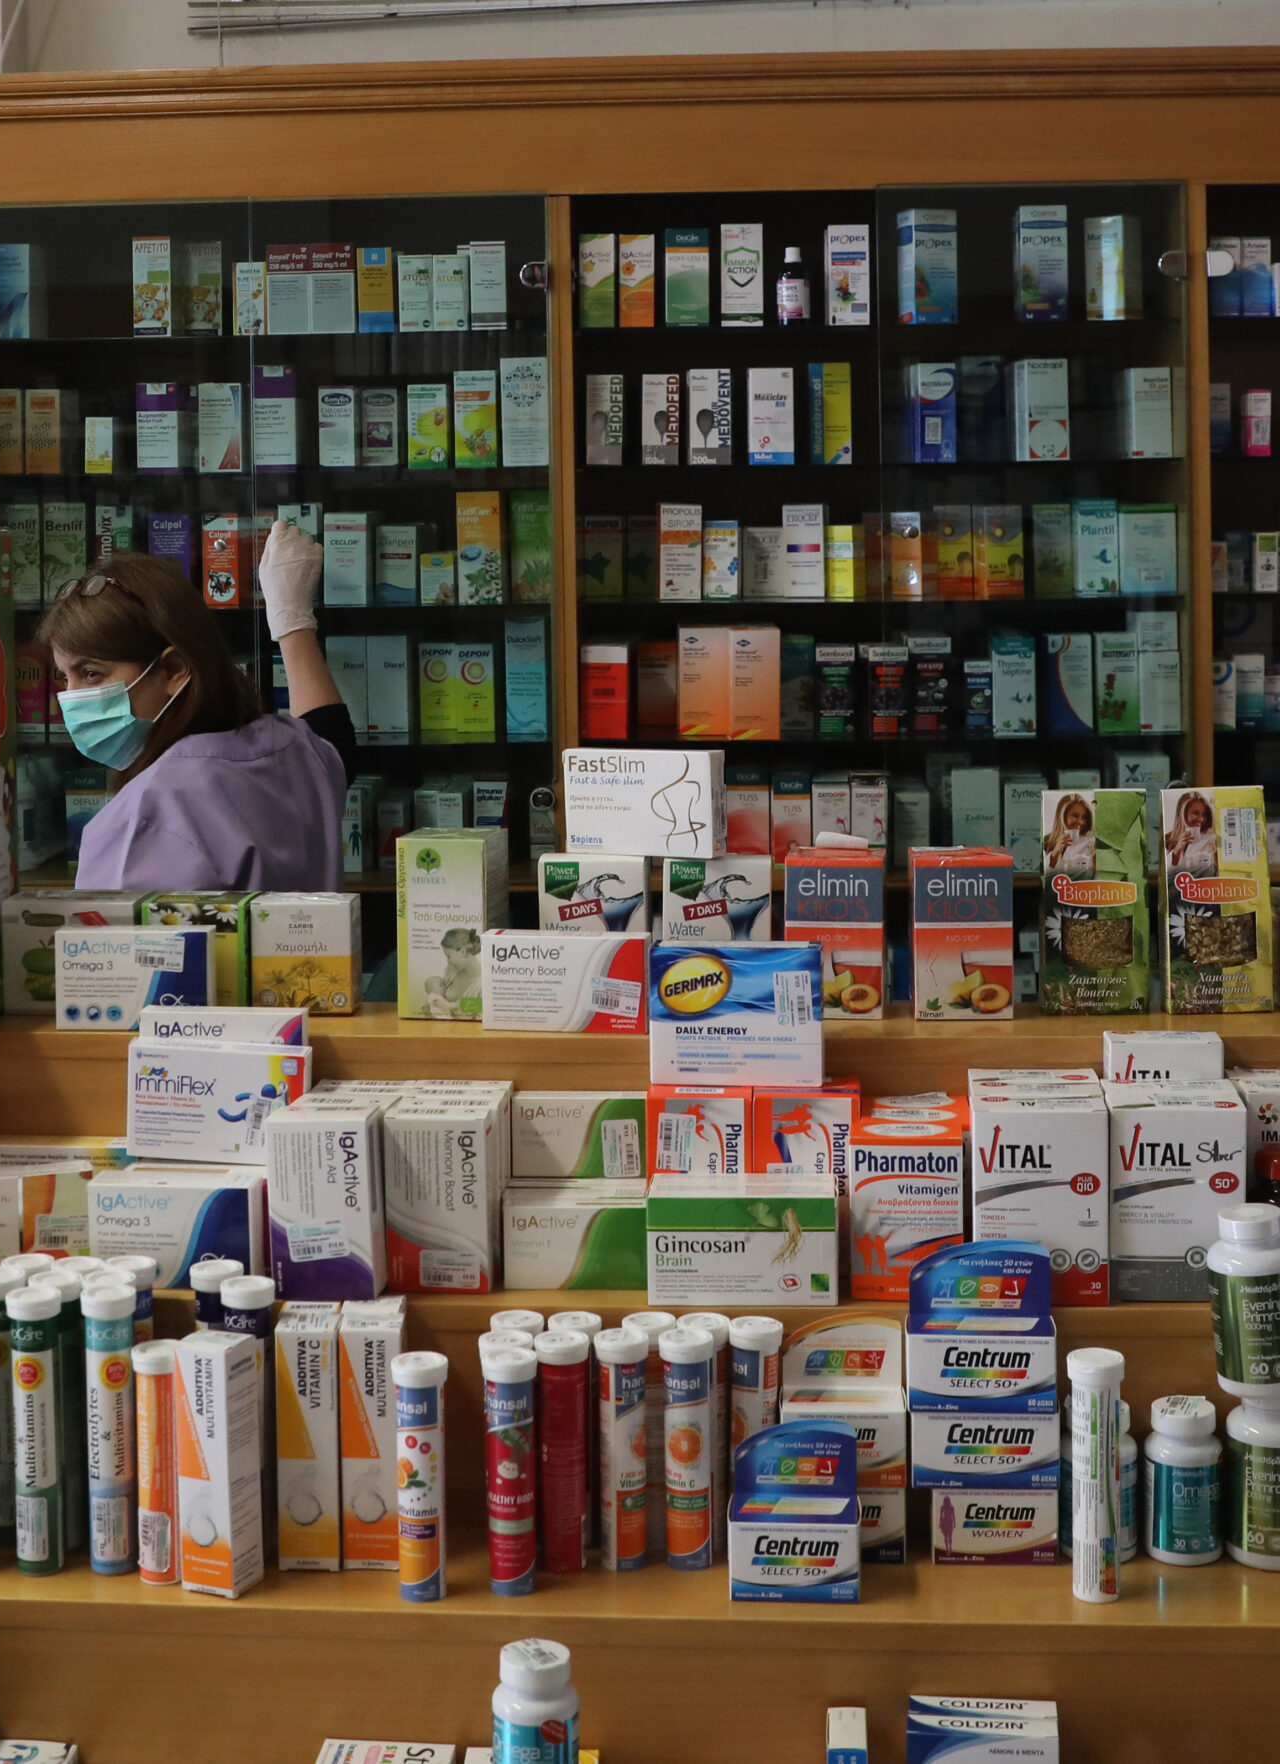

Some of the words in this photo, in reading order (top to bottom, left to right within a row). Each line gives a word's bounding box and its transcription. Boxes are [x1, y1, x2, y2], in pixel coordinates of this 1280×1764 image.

[830, 233, 866, 245] propex
[915, 237, 953, 249] propex
[621, 250, 652, 261] IgActive
[727, 258, 757, 267] IMMUN
[727, 266, 758, 275] ACTION
[754, 392, 788, 402] Moxiclav
[608, 375, 623, 447] MEDOFED
[718, 370, 731, 449] MEDOVENT
[662, 507, 701, 516] PROPOLIS
[45, 520, 84, 532] Benlif
[153, 519, 182, 532] Calpol
[1081, 524, 1114, 536] Plantil
[913, 640, 948, 649] Sambucol
[421, 648, 452, 657] DEPON
[458, 649, 490, 658] DEPON
[818, 650, 854, 658] Sambucol
[872, 650, 907, 658] Sambucol
[568, 755, 645, 774] FastSlim
[570, 775, 590, 785] Fast
[591, 776, 598, 785] &
[599, 775, 619, 785] Safe
[620, 775, 645, 785] slim
[570, 834, 603, 846] Sapiens
[554, 872, 579, 880] HEALTH
[680, 871, 704, 880] HEALTH
[798, 868, 869, 897] elimin
[927, 869, 999, 897] elimin
[1062, 883, 1132, 903] Bioplants
[1186, 882, 1256, 902] Bioplants
[564, 908, 570, 918] 7
[571, 902, 598, 917] DAYS
[689, 908, 695, 917] 7
[696, 902, 722, 916] DAYS
[668, 923, 706, 937] Water
[63, 939, 131, 956] IgActive
[274, 941, 328, 953] Χαμομήλι
[492, 944, 561, 961] IgActive
[63, 961, 103, 973] Omega
[106, 960, 114, 970] 3
[491, 965, 536, 977] Memory
[538, 965, 567, 976] Boost
[664, 969, 724, 997] GERIMAX
[918, 1010, 944, 1018] Tilman
[675, 1026, 705, 1036] DAILY
[707, 1026, 748, 1036] ENERGY
[134, 1072, 215, 1097] ImmiFlex
[325, 1131, 337, 1164] Brain
[444, 1129, 455, 1178] Memory
[979, 1124, 1052, 1173] VITAL
[854, 1150, 959, 1173] Pharmaton
[325, 1166, 337, 1184] Aid
[898, 1184, 958, 1199] Vitamigen
[1076, 1182, 1094, 1193] Q10
[444, 1179, 456, 1212] Boost
[878, 1197, 931, 1208] Αναβράζοντα
[96, 1214, 140, 1228] Omega
[143, 1214, 151, 1226] 3
[655, 1235, 746, 1254] Gincosan
[655, 1254, 692, 1267] Brain
[309, 1339, 321, 1350] C
[942, 1346, 1031, 1368] Centrum
[297, 1337, 308, 1398] ADDITIVA
[364, 1337, 375, 1398] ADDITIVA
[1249, 1362, 1269, 1376] 60
[309, 1353, 321, 1410] VITAMIN
[376, 1339, 386, 1418] MULTIVITAMIN
[949, 1378, 994, 1389] SELECT
[997, 1378, 1019, 1389] 50+
[193, 1355, 205, 1417] ADDITIVA
[204, 1357, 215, 1440] MULTIVITAMIN
[88, 1386, 100, 1481] Electrolytes
[946, 1423, 1034, 1444] Centrum
[953, 1454, 997, 1466] SELECT
[998, 1455, 1023, 1466] 50+
[964, 1502, 1036, 1521] Centrum
[971, 1528, 1024, 1540] WOMEN
[753, 1534, 839, 1557] Centrum
[760, 1566, 800, 1577] SELECT
[803, 1566, 829, 1577] 50+
[939, 1699, 1024, 1711] COLDIZIN
[938, 1718, 1023, 1730] COLDIZIN
